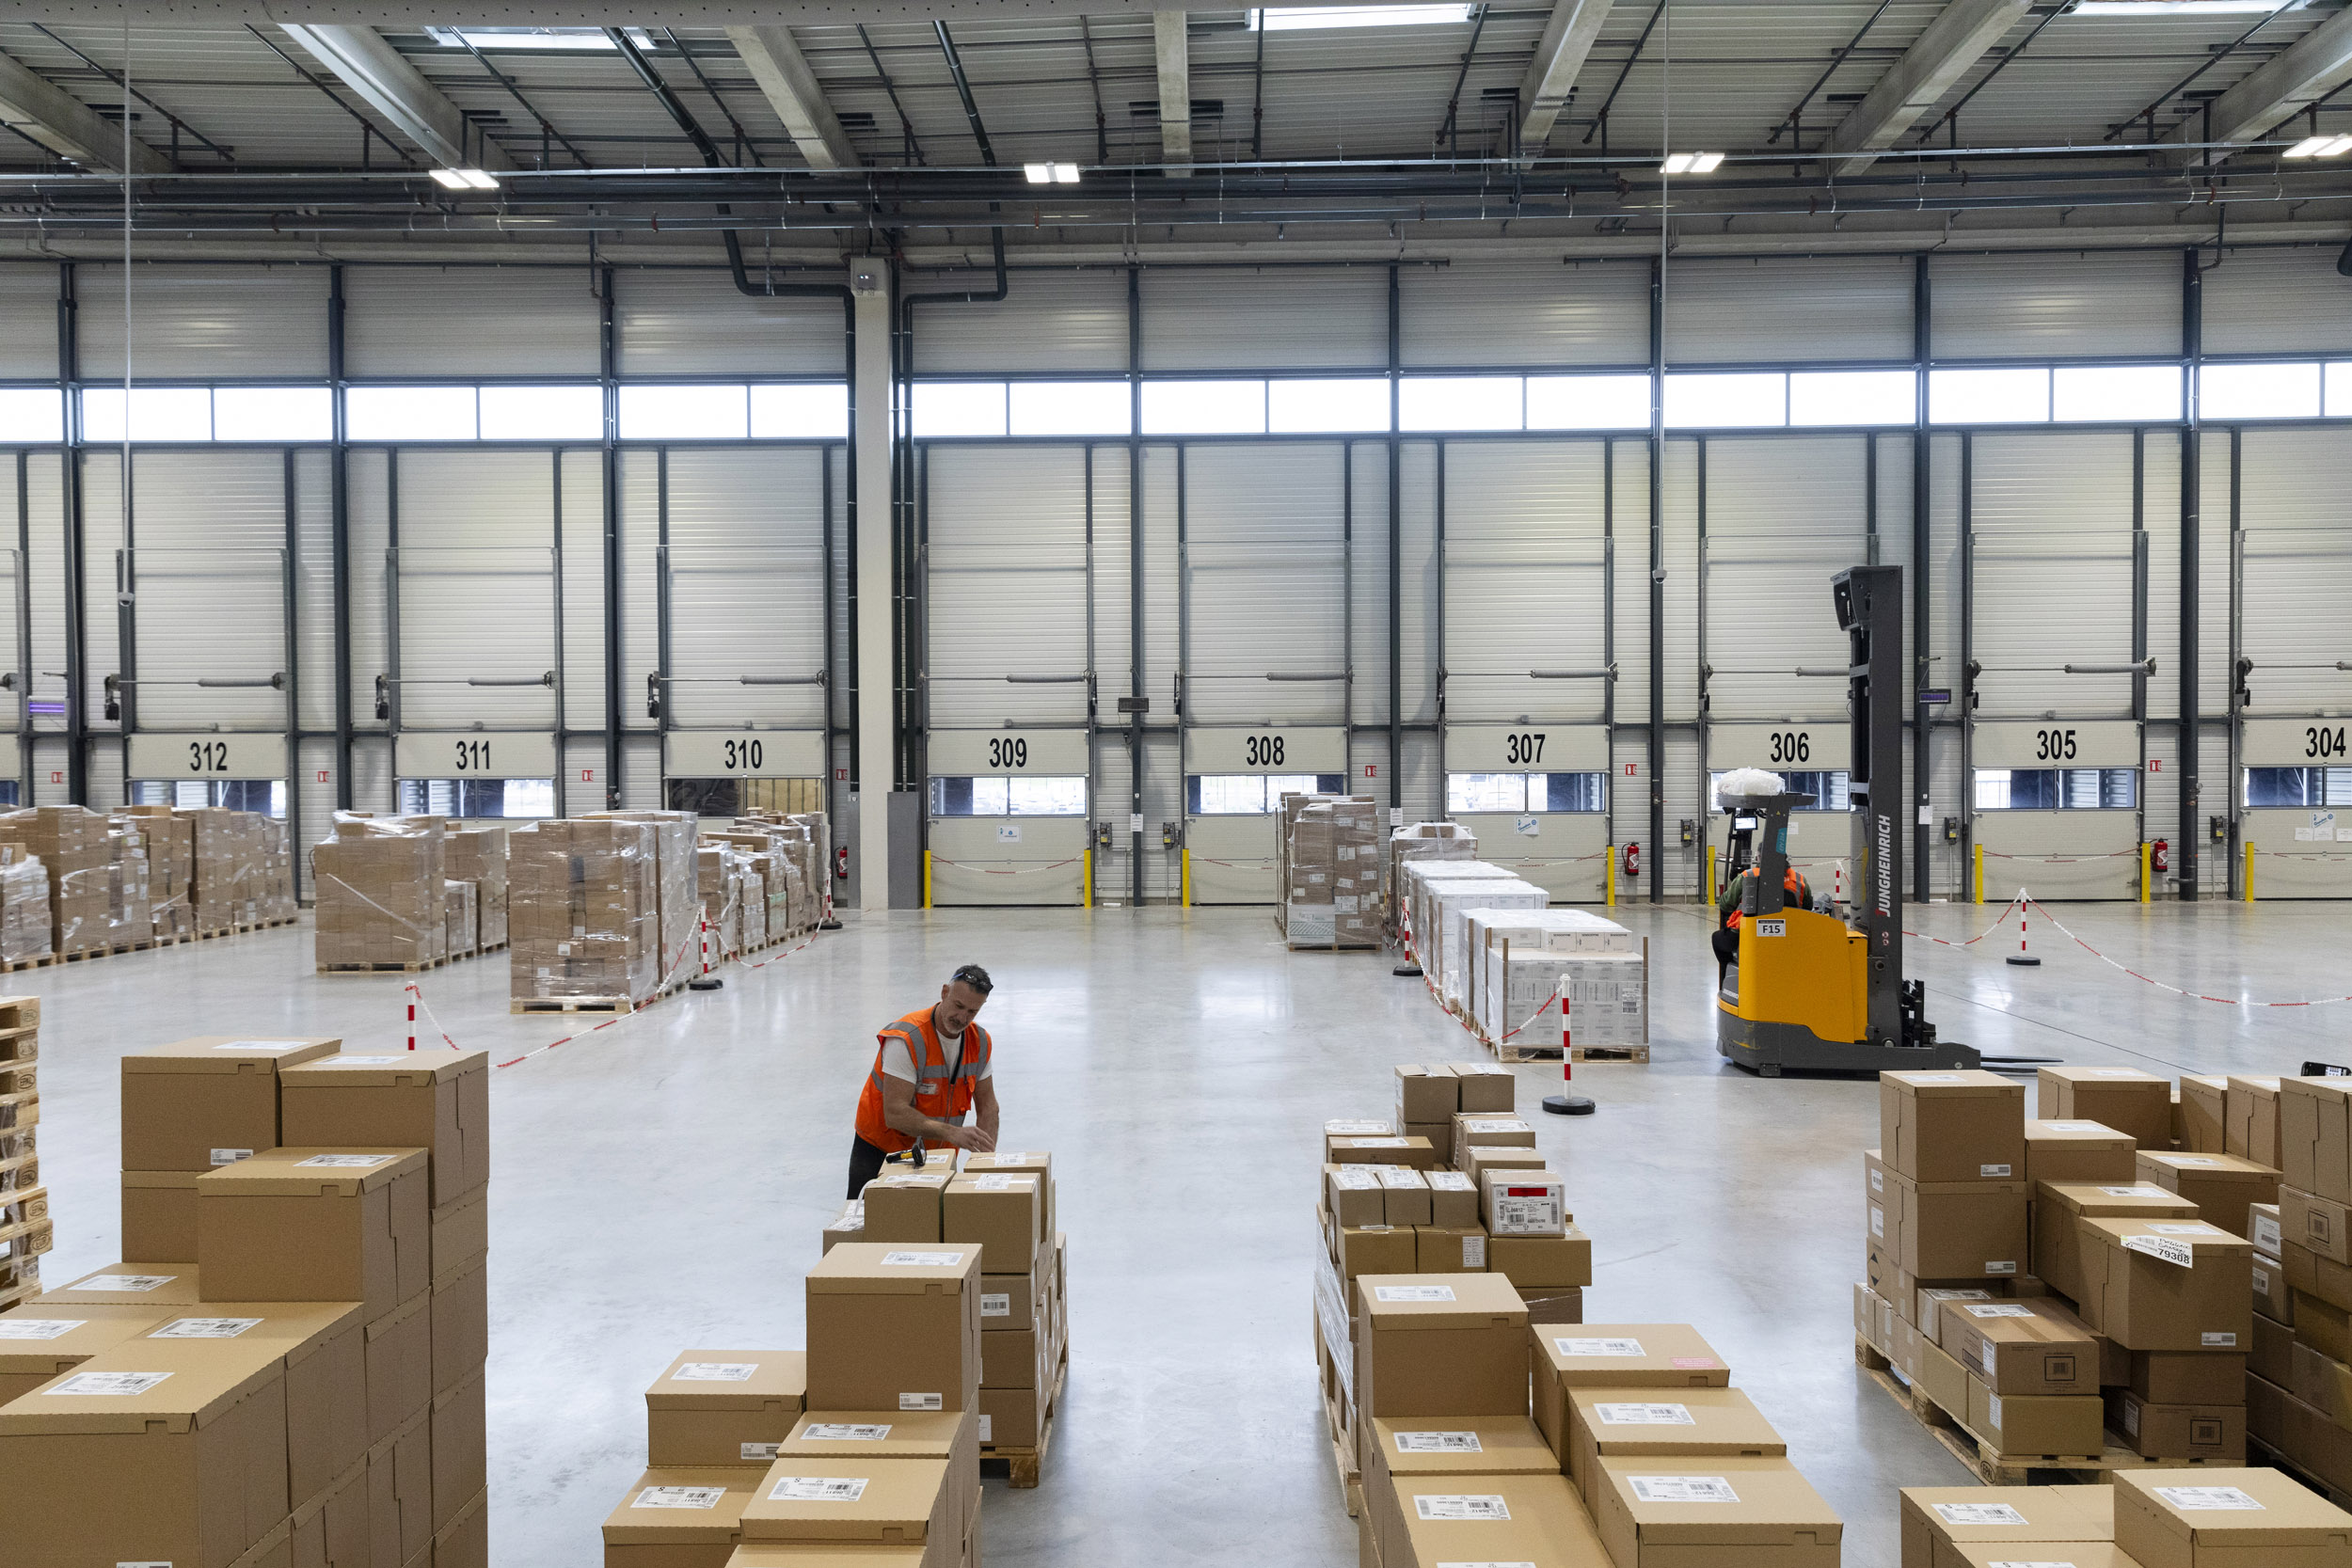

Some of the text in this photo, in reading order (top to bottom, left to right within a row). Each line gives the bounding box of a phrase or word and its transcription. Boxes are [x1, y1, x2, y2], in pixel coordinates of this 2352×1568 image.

[190, 742, 227, 771] 312
[456, 741, 490, 770] 311
[725, 740, 762, 769] 310
[990, 738, 1027, 768] 309
[1247, 736, 1284, 766] 308
[1507, 734, 1546, 764] 307
[1771, 733, 1809, 763] 306
[2037, 730, 2076, 760] 305
[2306, 727, 2346, 757] 304
[1878, 814, 1891, 918] JUNGHEINRICH
[1762, 925, 1781, 934] F15
[2157, 1248, 2190, 1265] 79308
